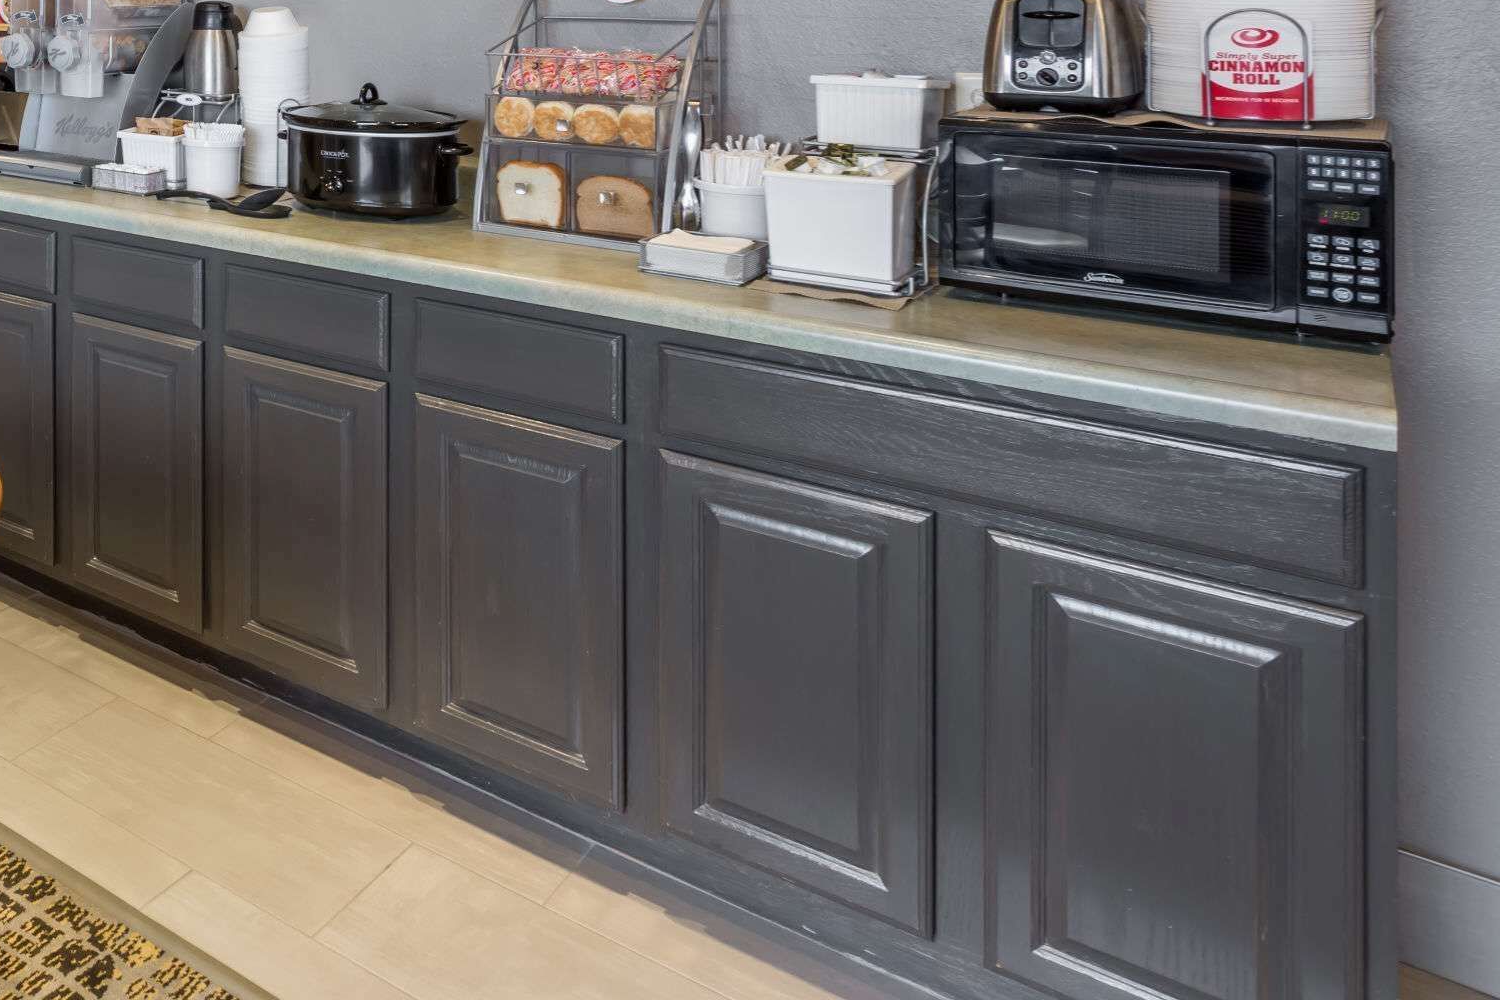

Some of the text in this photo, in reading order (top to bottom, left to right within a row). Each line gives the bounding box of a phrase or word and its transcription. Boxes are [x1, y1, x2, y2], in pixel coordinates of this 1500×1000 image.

[1216, 51, 1299, 62] Simply Super
[1207, 60, 1305, 73] CINNAMON
[1232, 73, 1280, 85] ROLL
[1083, 272, 1125, 285] Sunbeam
